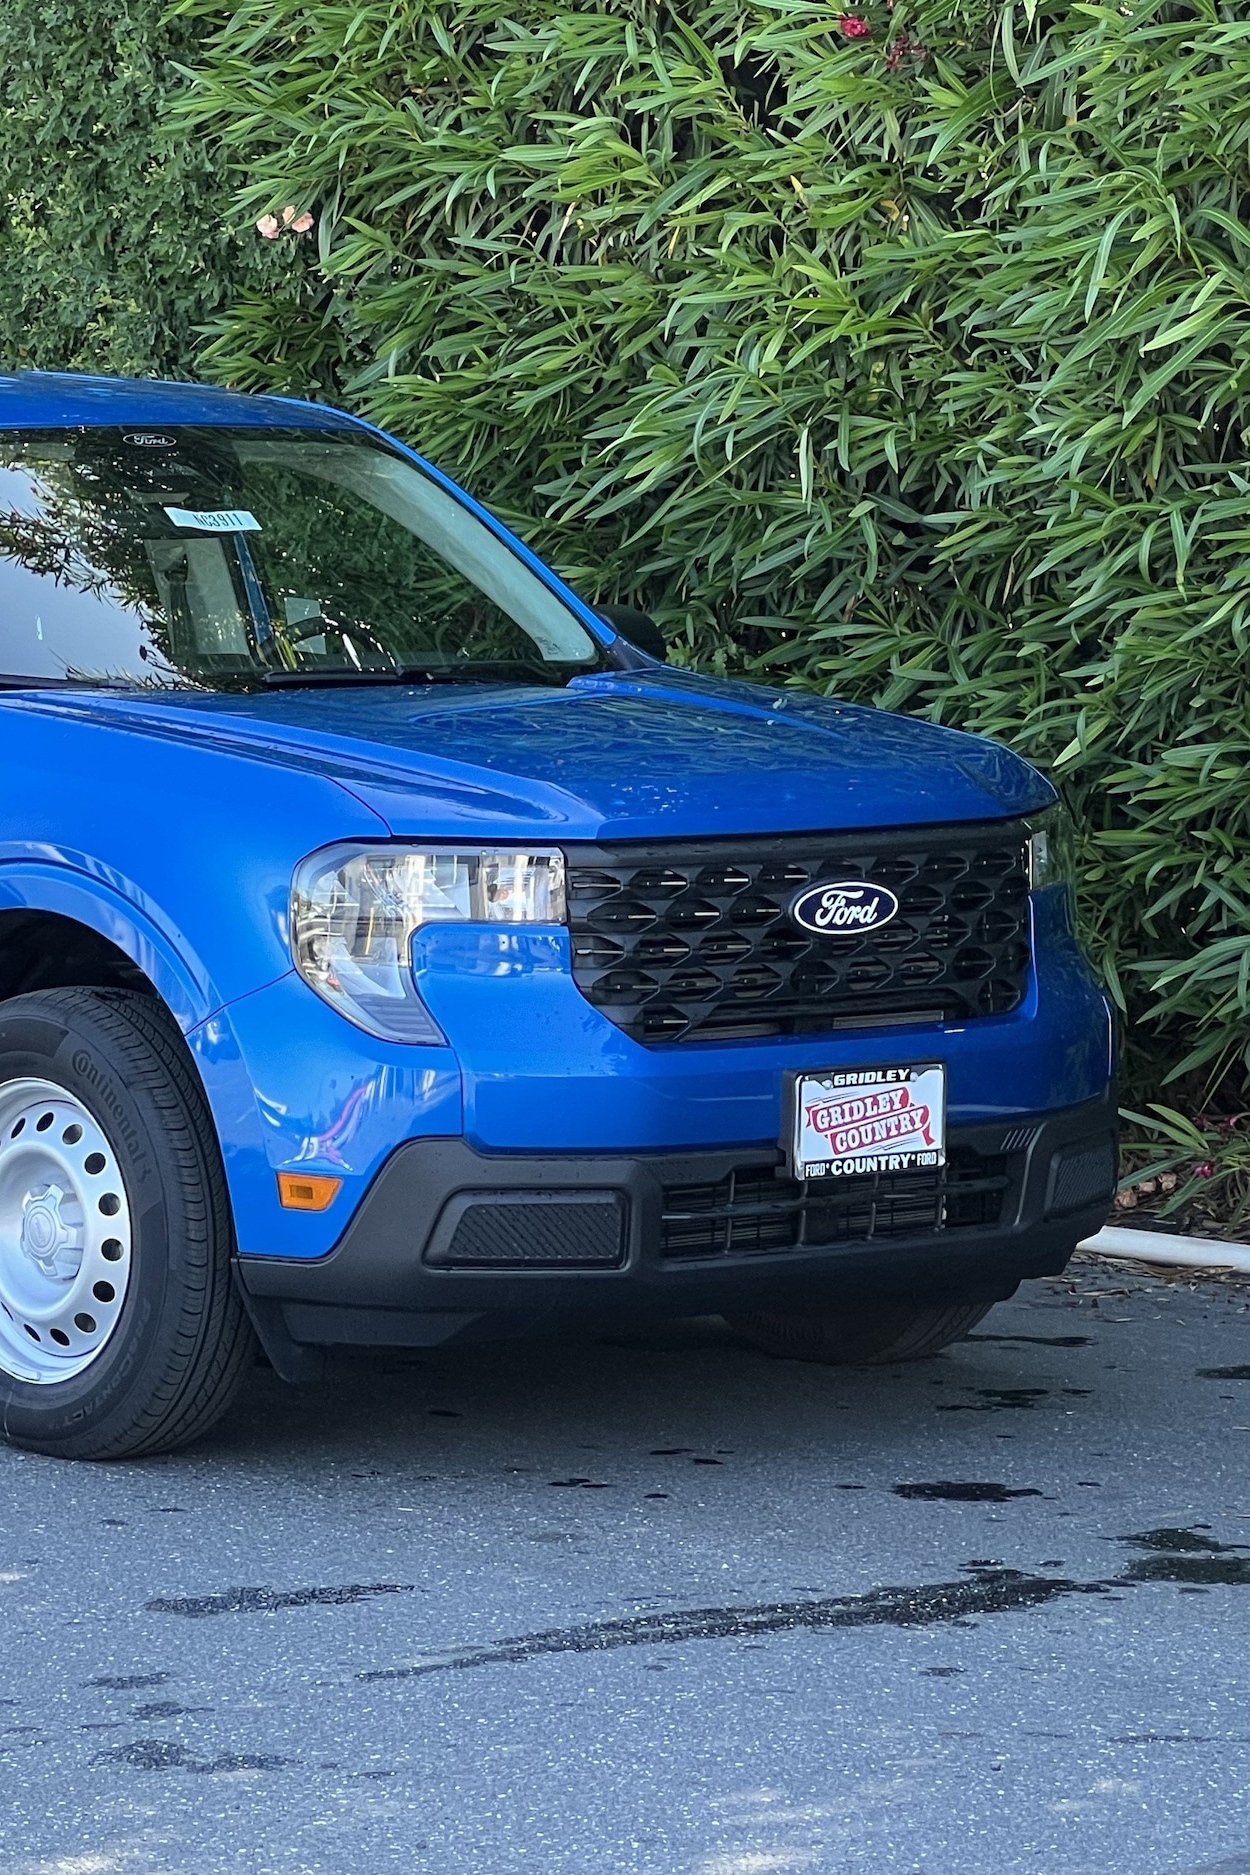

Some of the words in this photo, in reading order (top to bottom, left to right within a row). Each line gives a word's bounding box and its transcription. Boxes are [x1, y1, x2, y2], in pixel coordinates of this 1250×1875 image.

[133, 435, 169, 446] Ford
[815, 889, 880, 926] Ford
[833, 1068, 910, 1087] GRIDLEY
[71, 1049, 148, 1164] Continental
[816, 1088, 904, 1130] GRIDLEY
[834, 1108, 925, 1152] COUNTRY
[805, 1163, 826, 1177] FORD
[830, 1153, 912, 1176] COUNTRY
[916, 1151, 937, 1166] FORD
